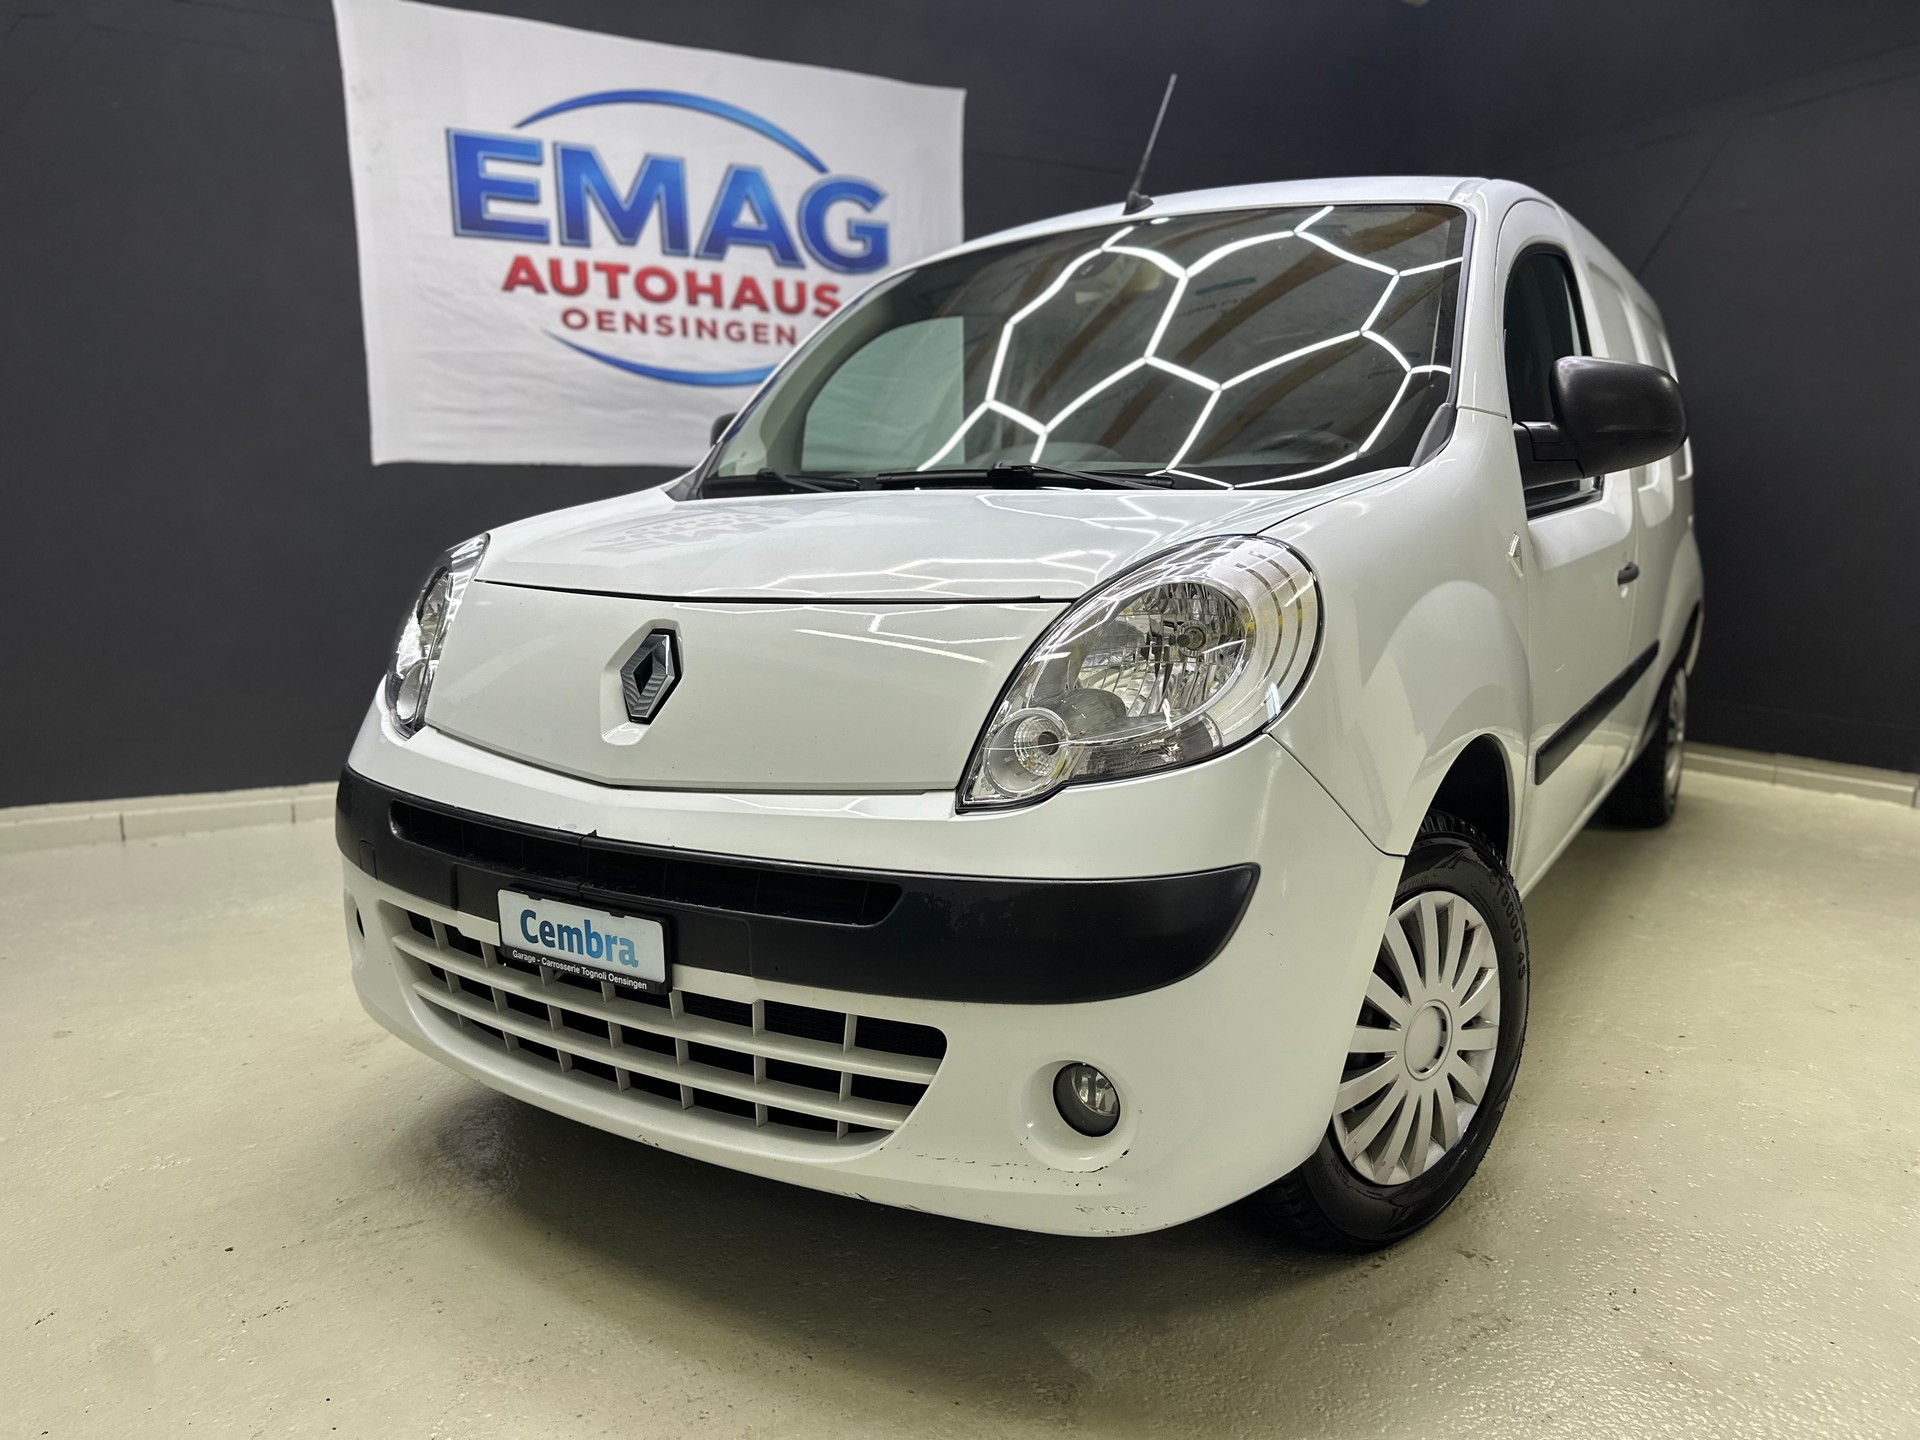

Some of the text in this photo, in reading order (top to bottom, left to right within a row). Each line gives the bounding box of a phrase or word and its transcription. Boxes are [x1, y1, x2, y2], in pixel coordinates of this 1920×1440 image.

[446, 128, 889, 275] EMAG
[502, 255, 842, 319] AUTOHAUS
[562, 308, 797, 347] OENSINGEN
[520, 909, 639, 968] Cembra
[512, 949, 536, 964] Garage
[541, 956, 580, 974] Carrosserie
[581, 965, 607, 981] Tognoli
[608, 972, 647, 990] Oensingen
